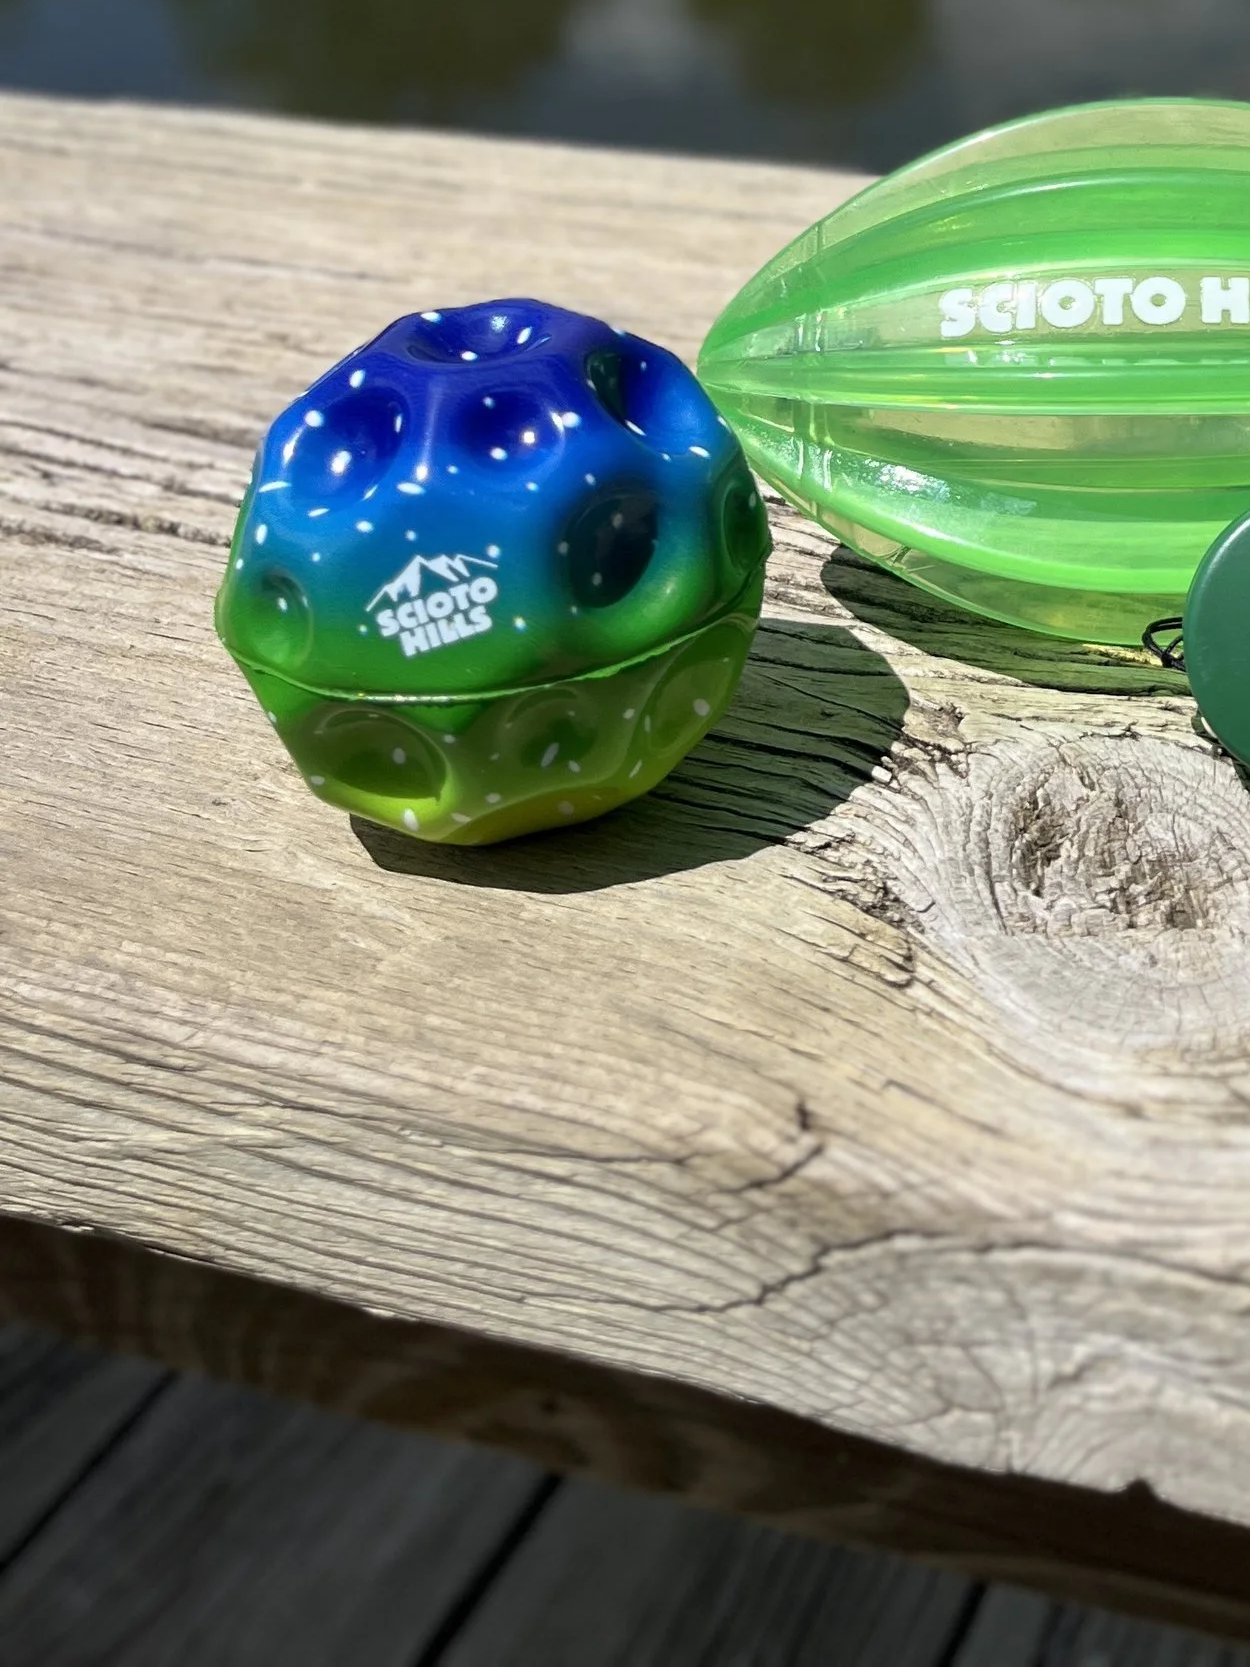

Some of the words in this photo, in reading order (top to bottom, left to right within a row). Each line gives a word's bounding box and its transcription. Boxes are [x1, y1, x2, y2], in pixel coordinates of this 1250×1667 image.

[940, 277, 1186, 339] SCIOTO
[376, 576, 498, 637] SCIOTO
[400, 605, 493, 657] HILLS
